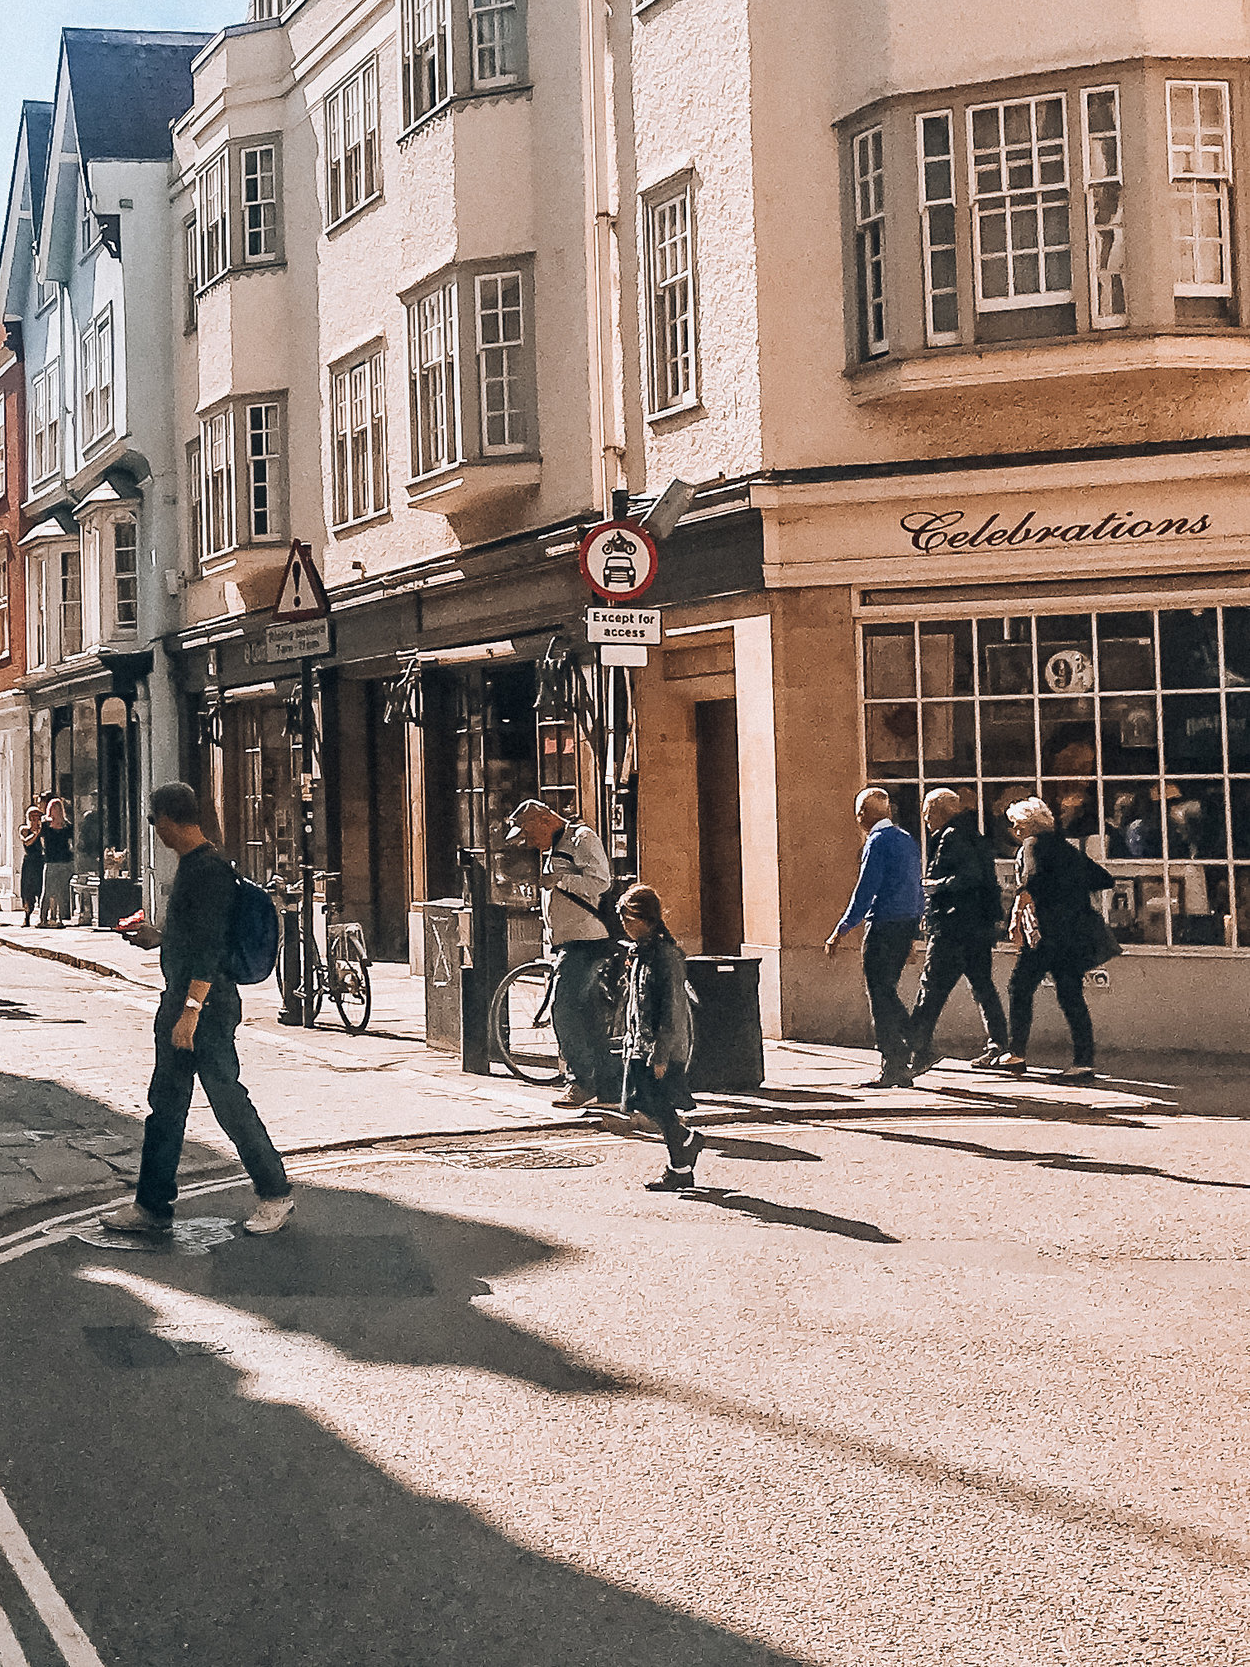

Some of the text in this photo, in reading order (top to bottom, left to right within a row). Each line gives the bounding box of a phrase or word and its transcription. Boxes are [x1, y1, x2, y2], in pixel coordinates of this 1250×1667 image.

[900, 510, 1212, 554] Celebrations
[592, 611, 656, 625] Except for
[603, 628, 646, 638] access
